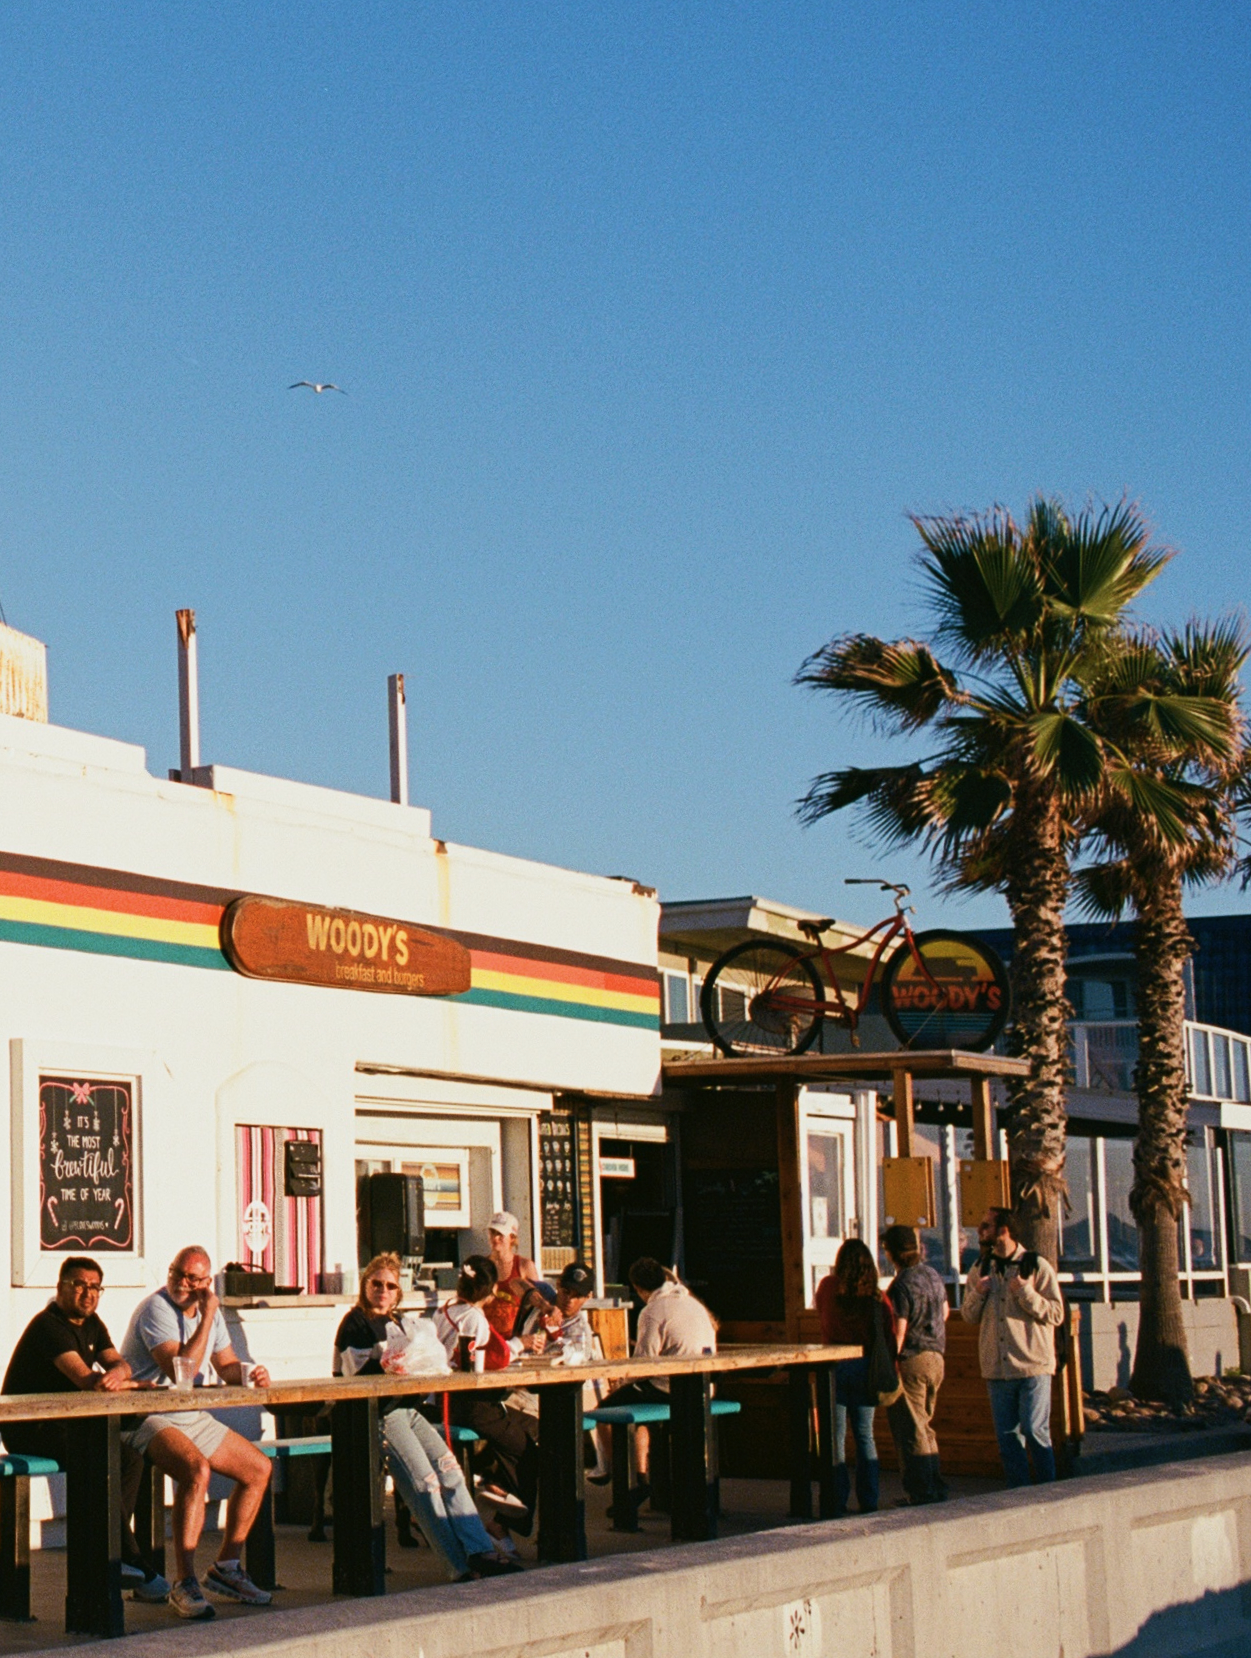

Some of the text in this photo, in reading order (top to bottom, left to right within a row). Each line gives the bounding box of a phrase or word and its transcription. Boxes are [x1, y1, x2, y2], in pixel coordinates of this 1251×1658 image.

[306, 913, 409, 966] WOODY'S
[335, 960, 425, 991] breakfast and burgers
[892, 982, 1002, 1010] WOODY'S
[66, 1134, 101, 1149] THE MOST
[60, 1188, 112, 1201] TIME OF YEAR
